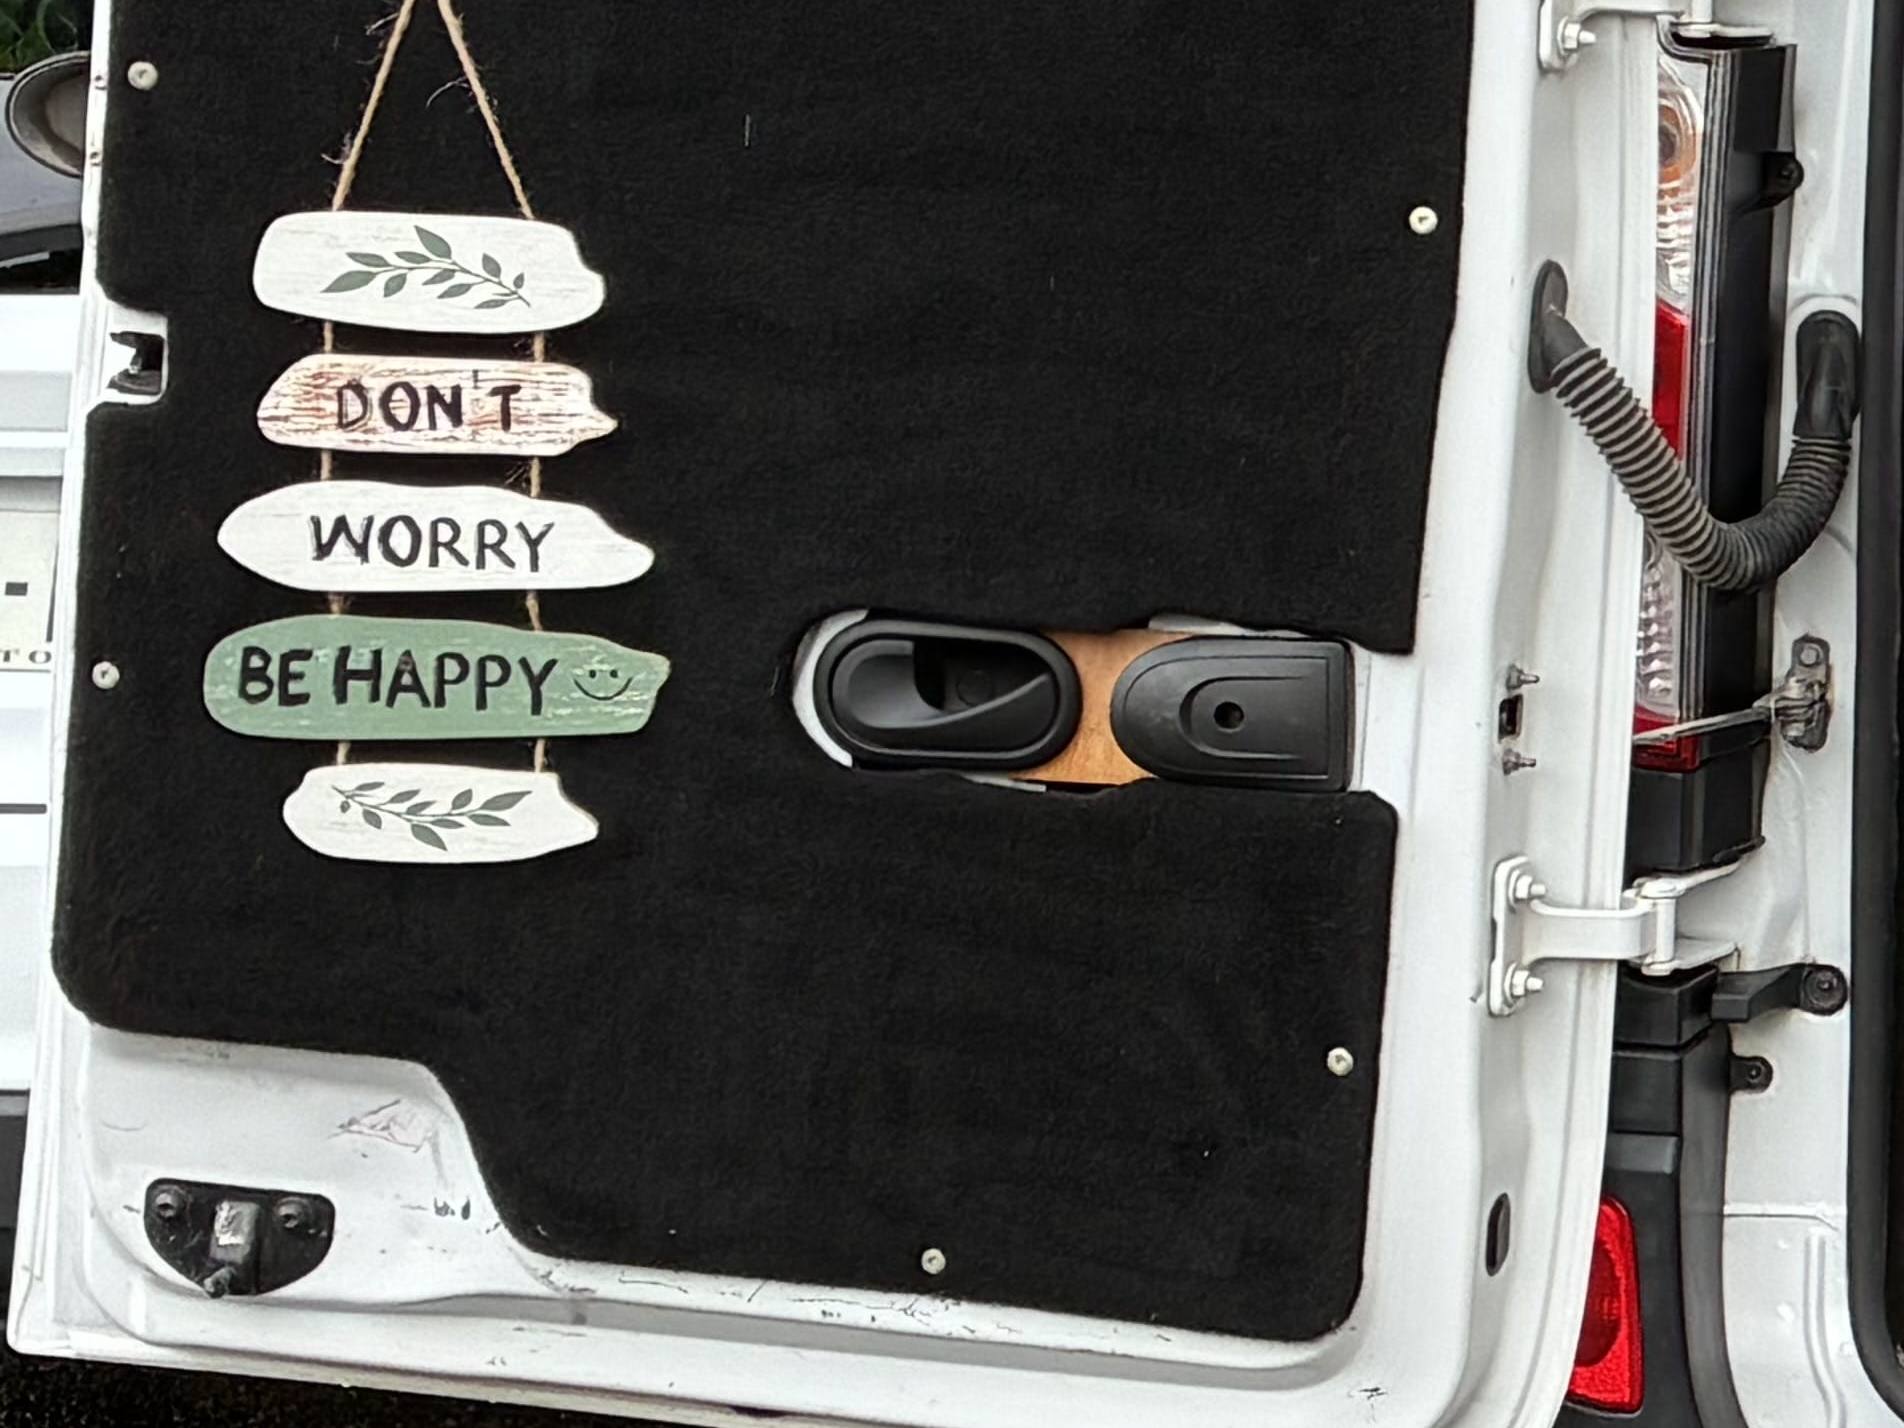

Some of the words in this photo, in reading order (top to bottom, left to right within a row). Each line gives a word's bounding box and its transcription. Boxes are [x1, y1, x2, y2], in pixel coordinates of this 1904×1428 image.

[335, 369, 523, 433] DON'T
[310, 514, 555, 573] WORRY
[237, 645, 313, 707] BE
[332, 645, 558, 716] HAPPY
